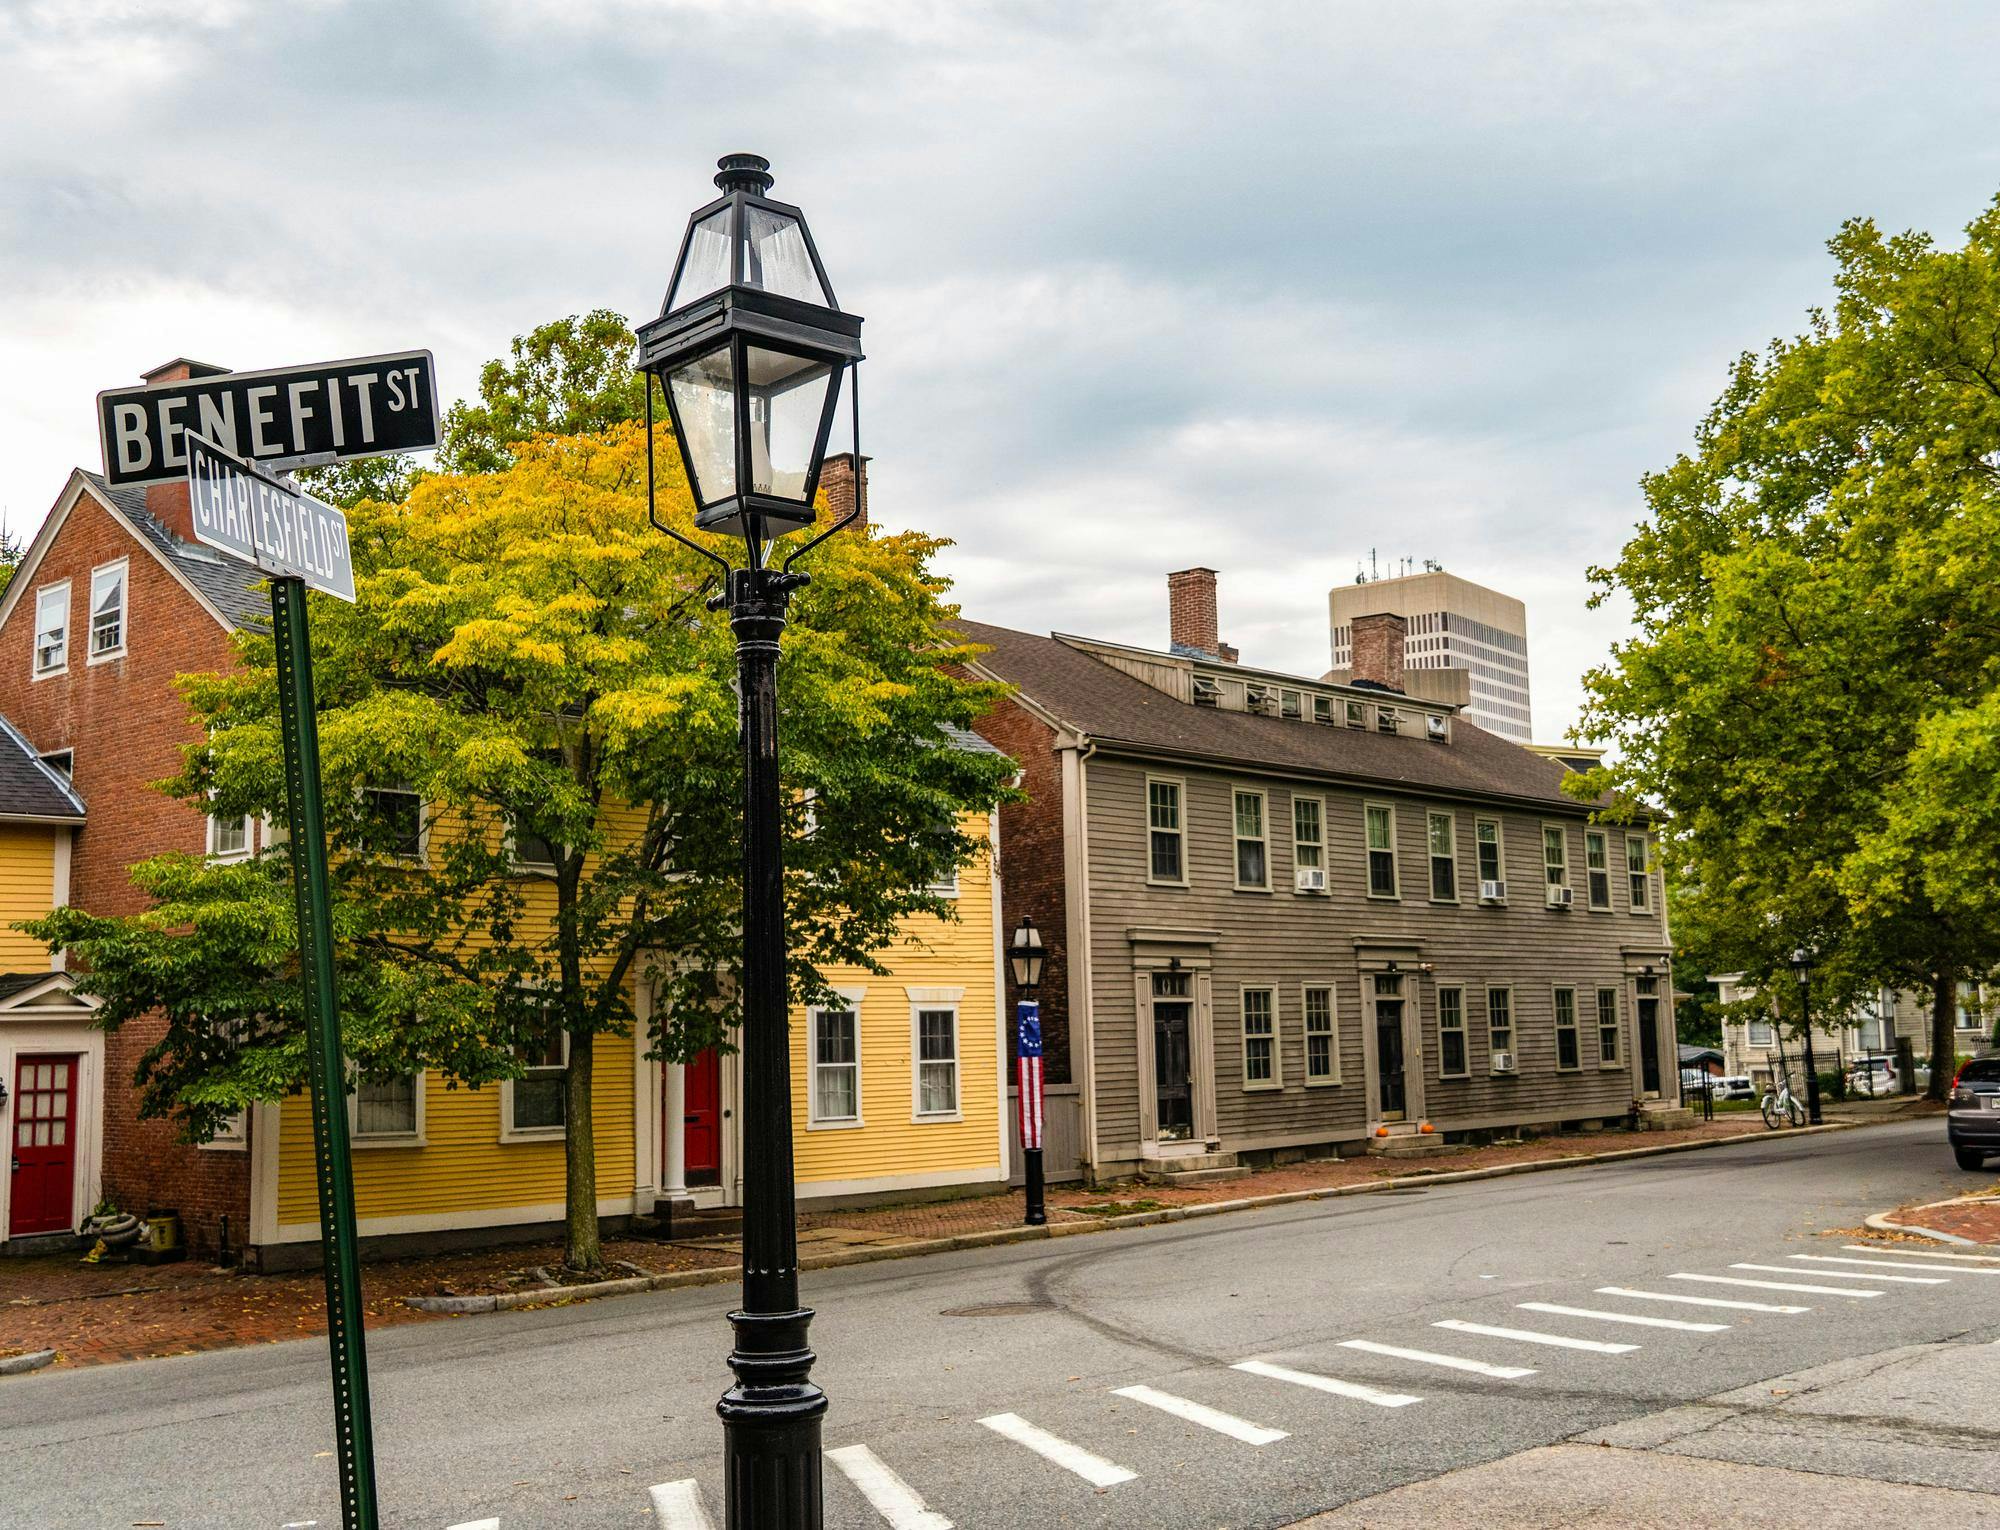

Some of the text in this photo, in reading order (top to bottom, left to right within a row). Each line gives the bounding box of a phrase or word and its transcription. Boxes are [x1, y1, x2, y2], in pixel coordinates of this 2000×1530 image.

[113, 367, 420, 474] BENEFIT ST
[195, 449, 345, 579] CHARLESFIELD ST
